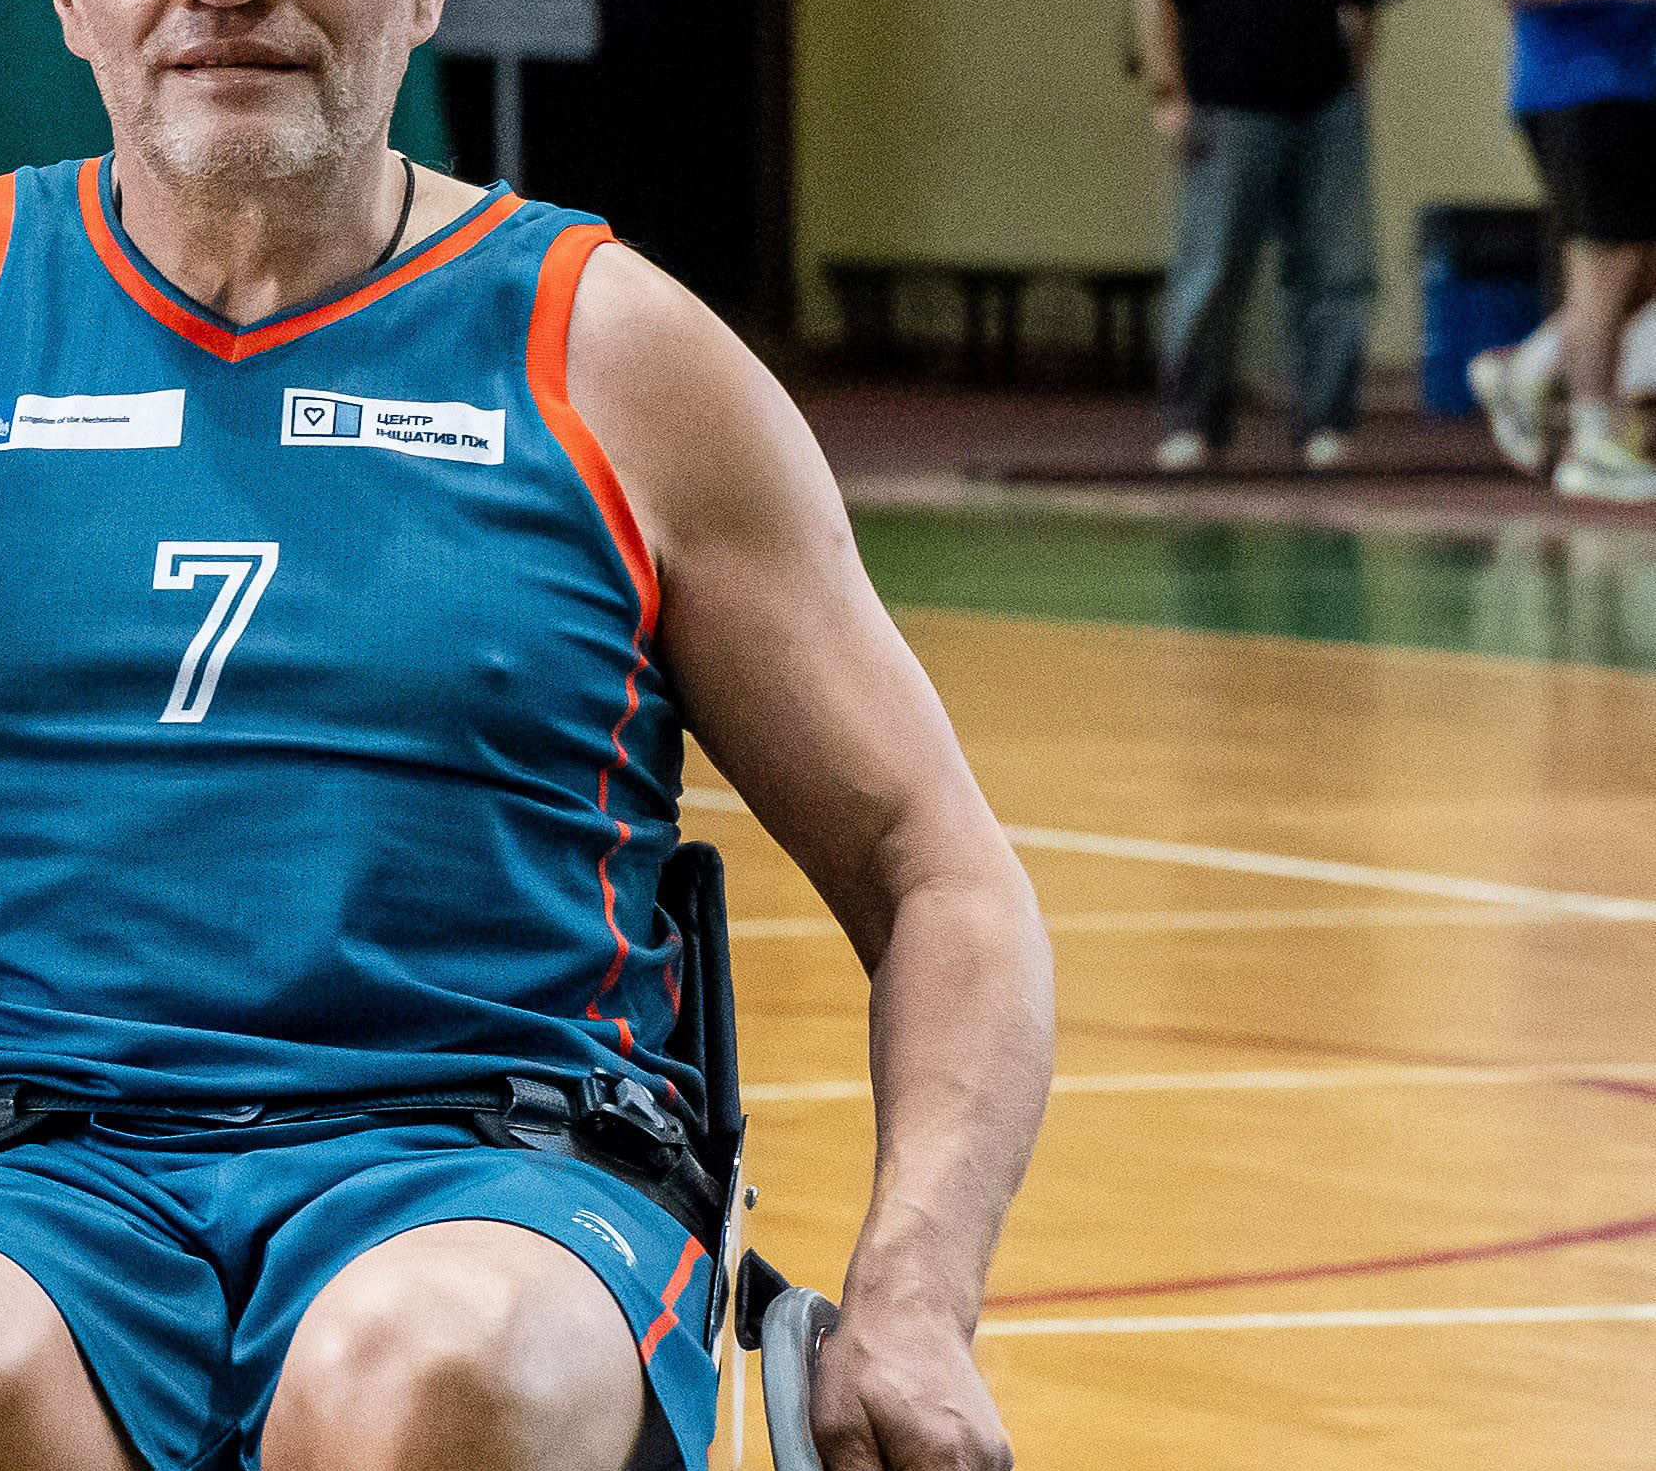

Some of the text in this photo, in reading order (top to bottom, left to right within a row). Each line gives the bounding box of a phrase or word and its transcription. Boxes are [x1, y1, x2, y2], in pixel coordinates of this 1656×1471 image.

[67, 415, 79, 423] the
[377, 413, 433, 426] ЦЕНТР
[152, 541, 280, 725] 7
